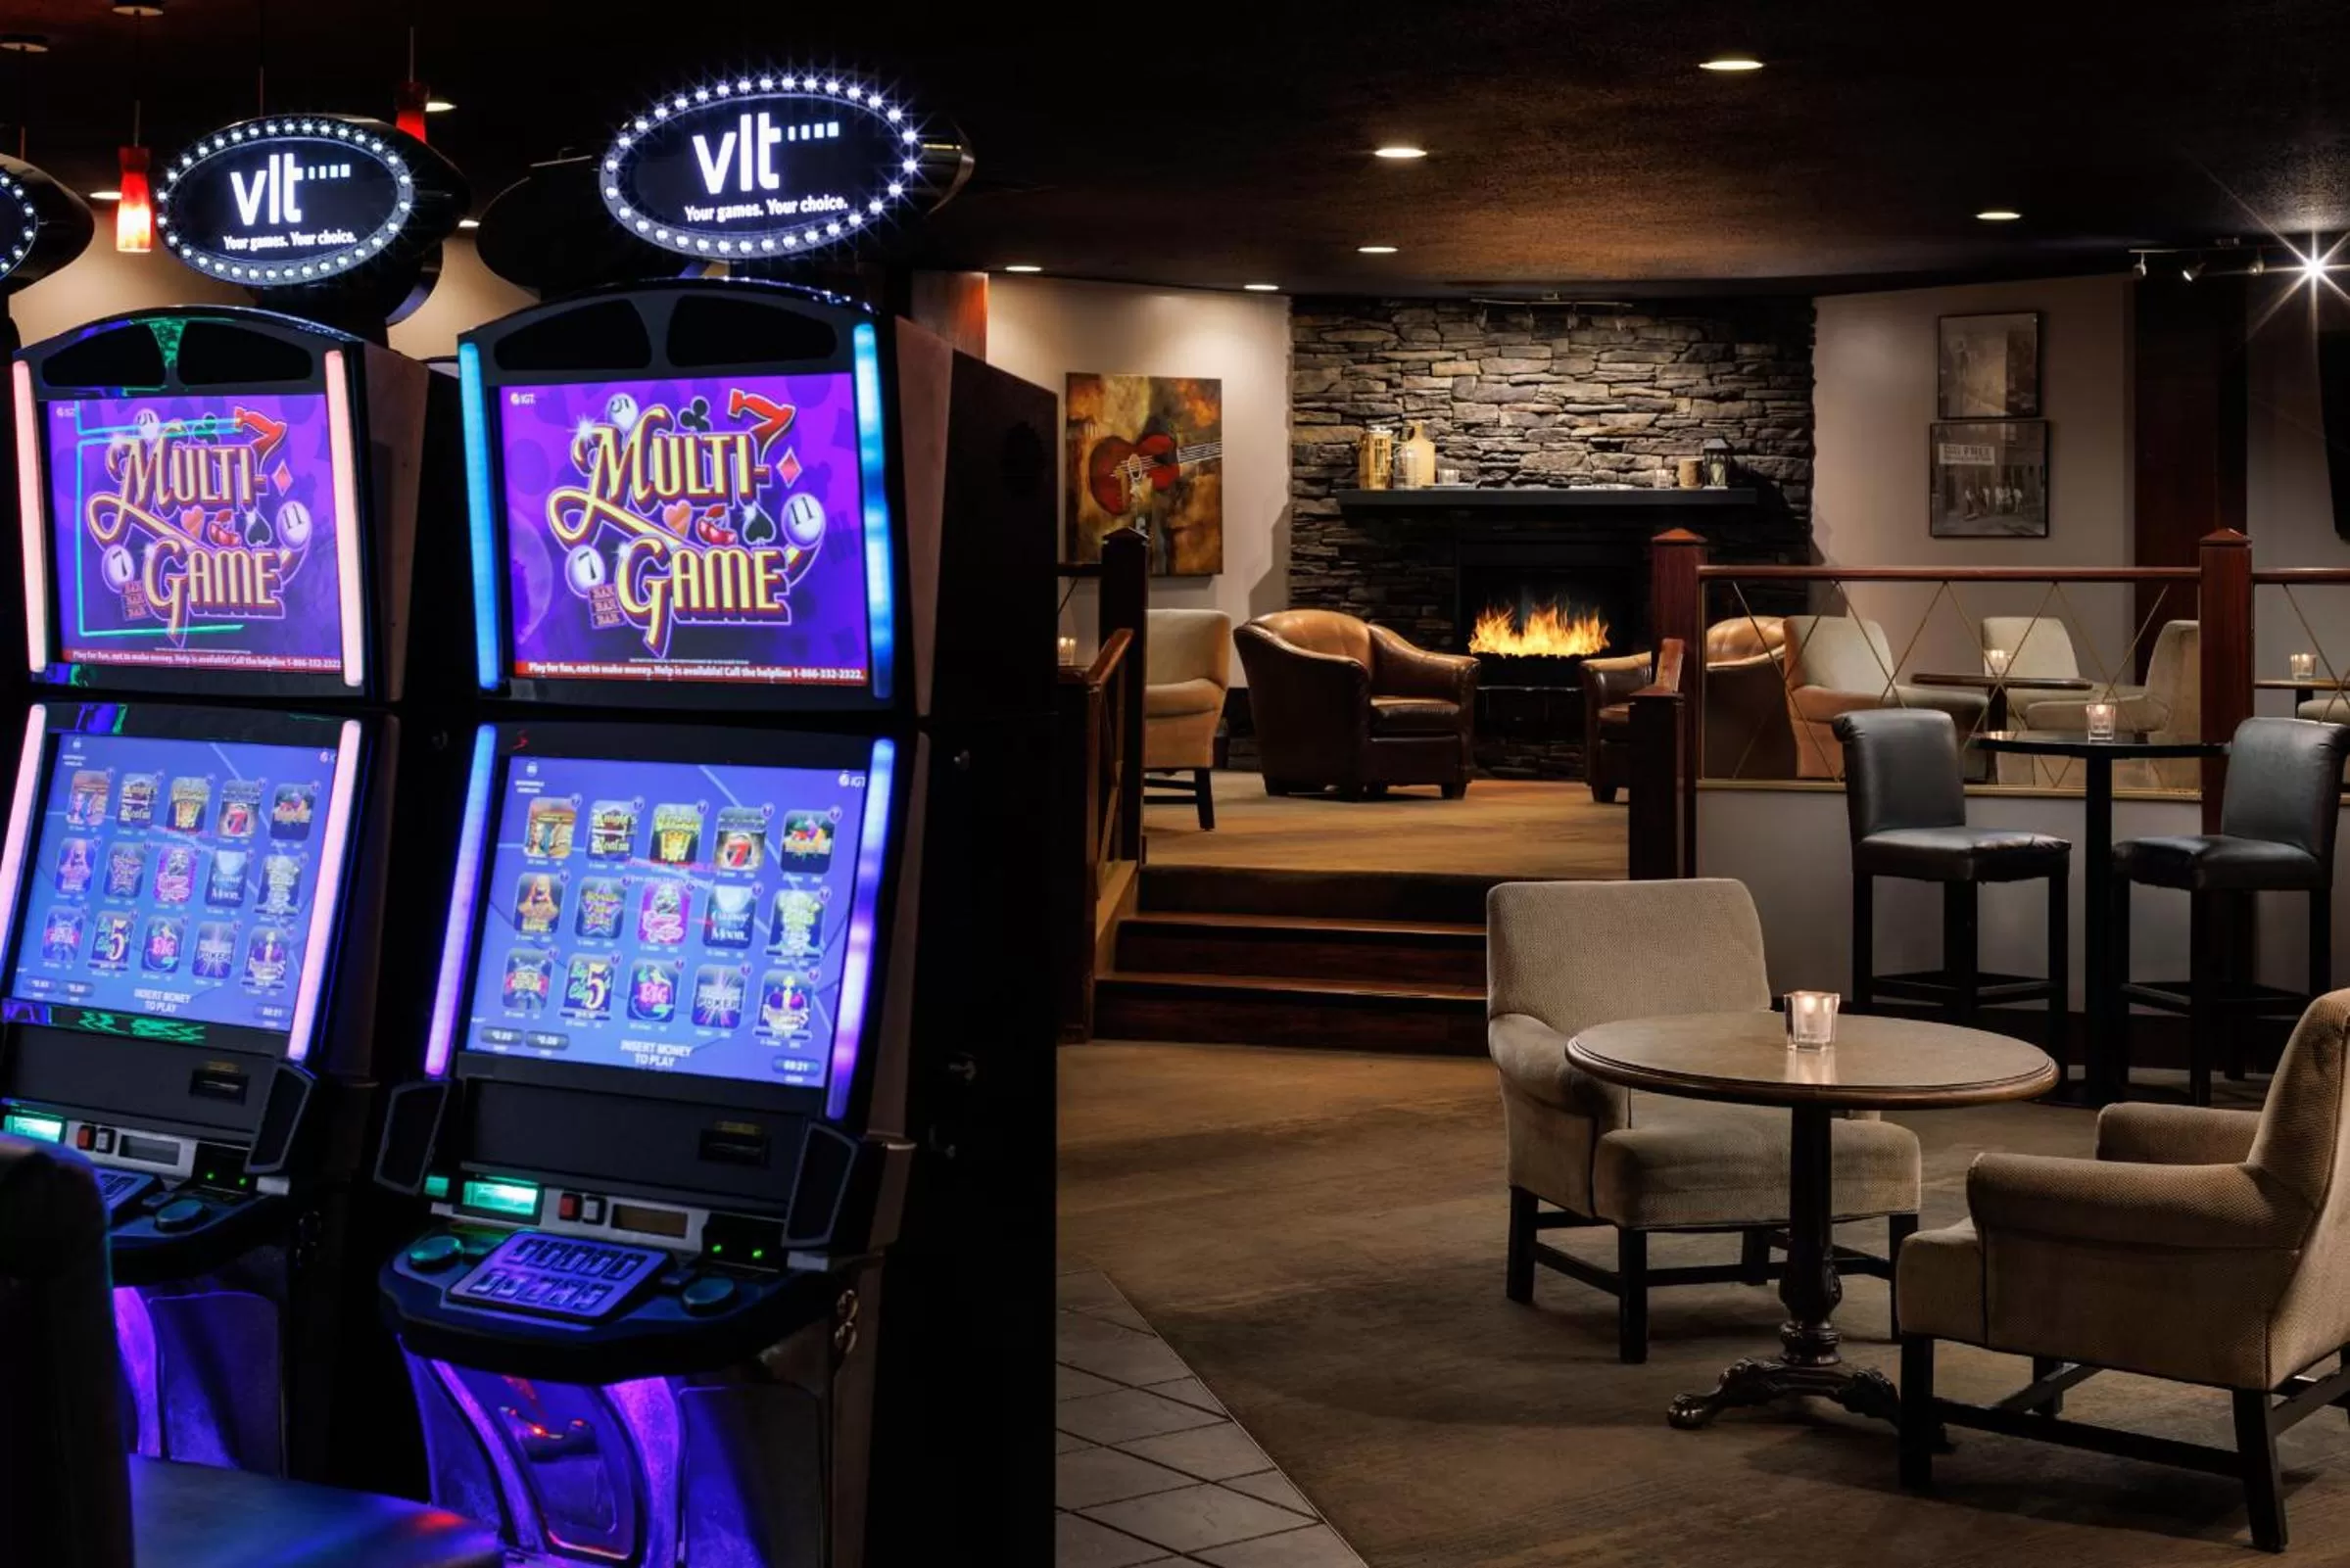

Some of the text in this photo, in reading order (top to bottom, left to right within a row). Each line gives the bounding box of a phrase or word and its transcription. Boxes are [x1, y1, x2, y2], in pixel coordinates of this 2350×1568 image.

[693, 113, 781, 195] vlt
[230, 153, 304, 225] vlt
[685, 194, 848, 223] Your games. Your choice.
[223, 228, 358, 252] Your games. Your choice.
[528, 662, 546, 675] Play
[725, 666, 741, 678] Call
[620, 1039, 694, 1058] INSERT MONEY
[635, 1053, 676, 1069] TO PLAY
